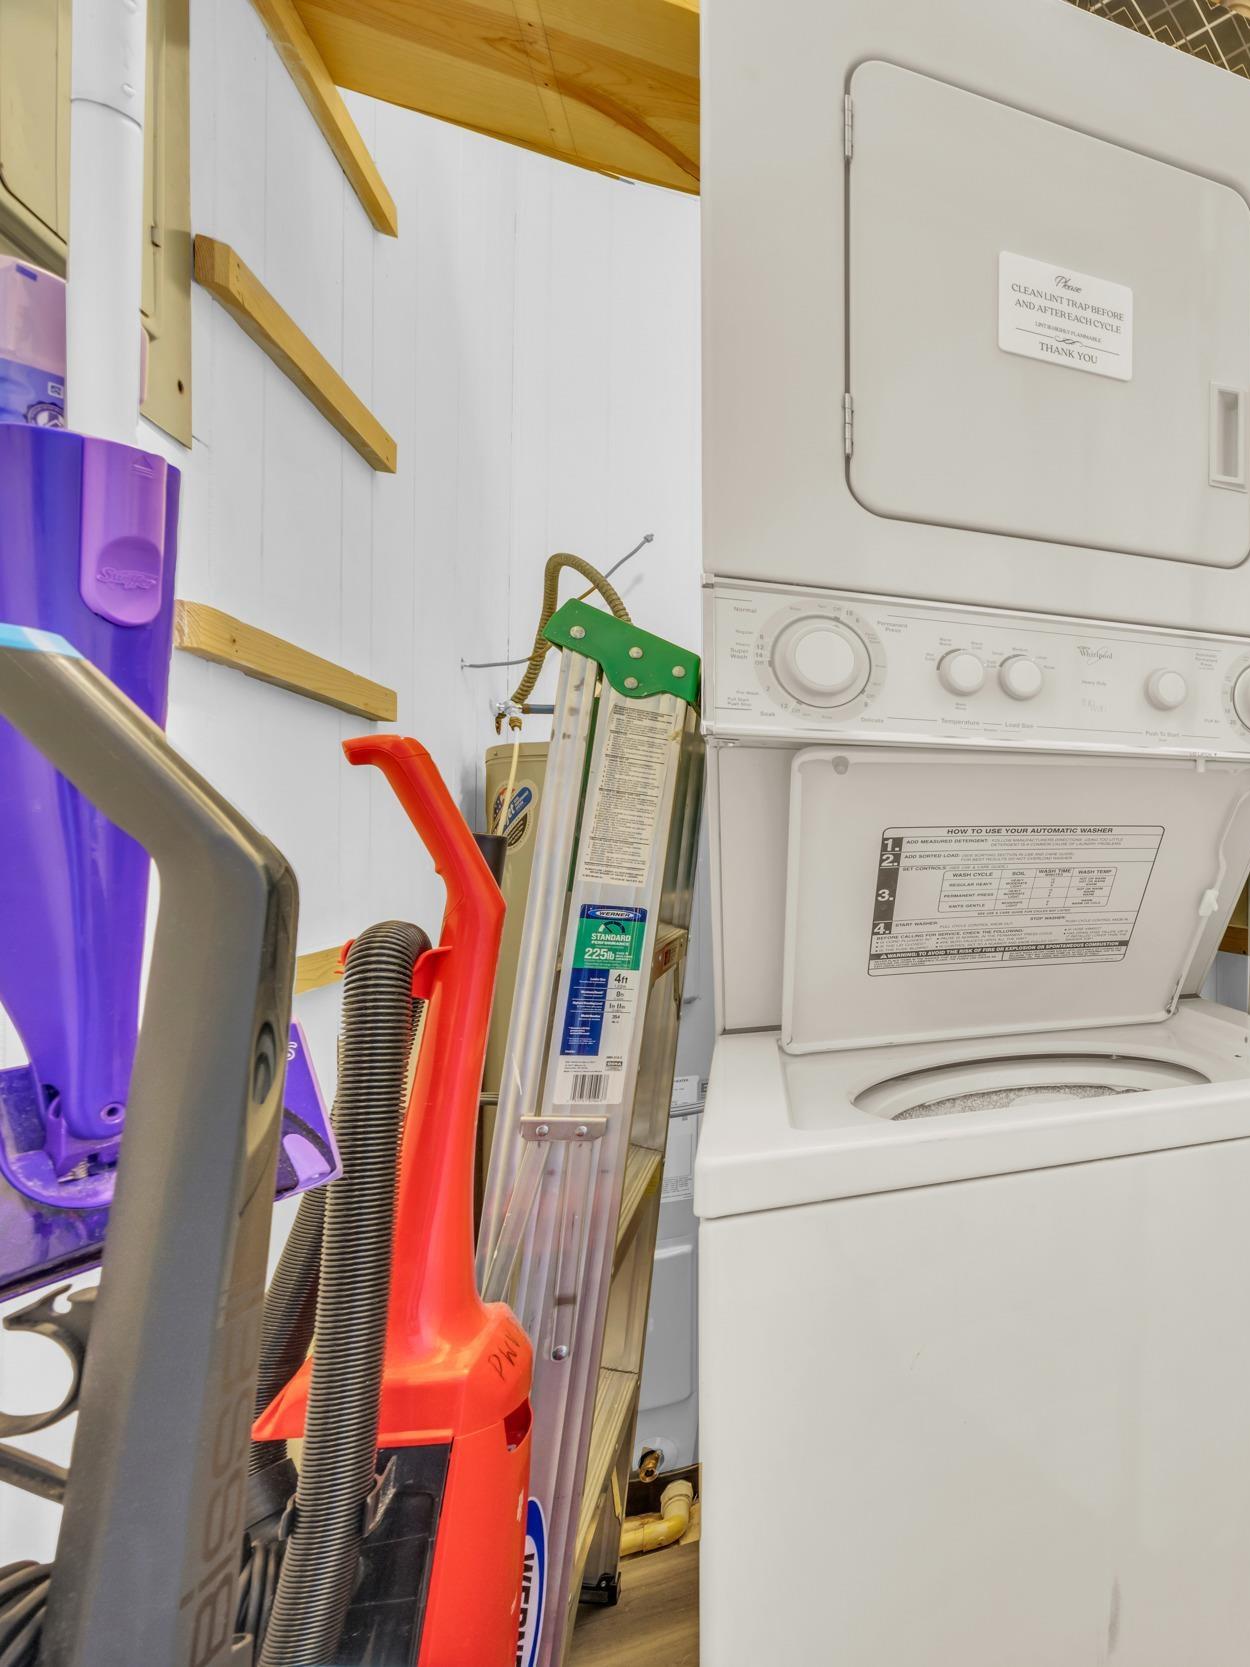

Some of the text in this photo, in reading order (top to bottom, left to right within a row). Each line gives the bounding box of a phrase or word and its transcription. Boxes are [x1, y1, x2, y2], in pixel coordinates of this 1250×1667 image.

[1054, 275, 1082, 294] Please
[1011, 283, 1124, 322] CLEAN LINT TRAP BEFORE
[1014, 298, 1121, 334] AND AFTER EACH CYCLE
[1038, 341, 1098, 364] THANK YOU
[96, 565, 157, 590] Swiffer
[1076, 645, 1113, 662] Whirlpool
[941, 717, 980, 726] Temperature
[883, 838, 900, 851] 1.
[880, 853, 899, 866] 2.
[877, 888, 894, 900] 3.
[874, 922, 890, 934] 4.
[591, 932, 632, 942] STANDARD
[583, 947, 615, 960] 225lb
[614, 973, 629, 984] 4ft
